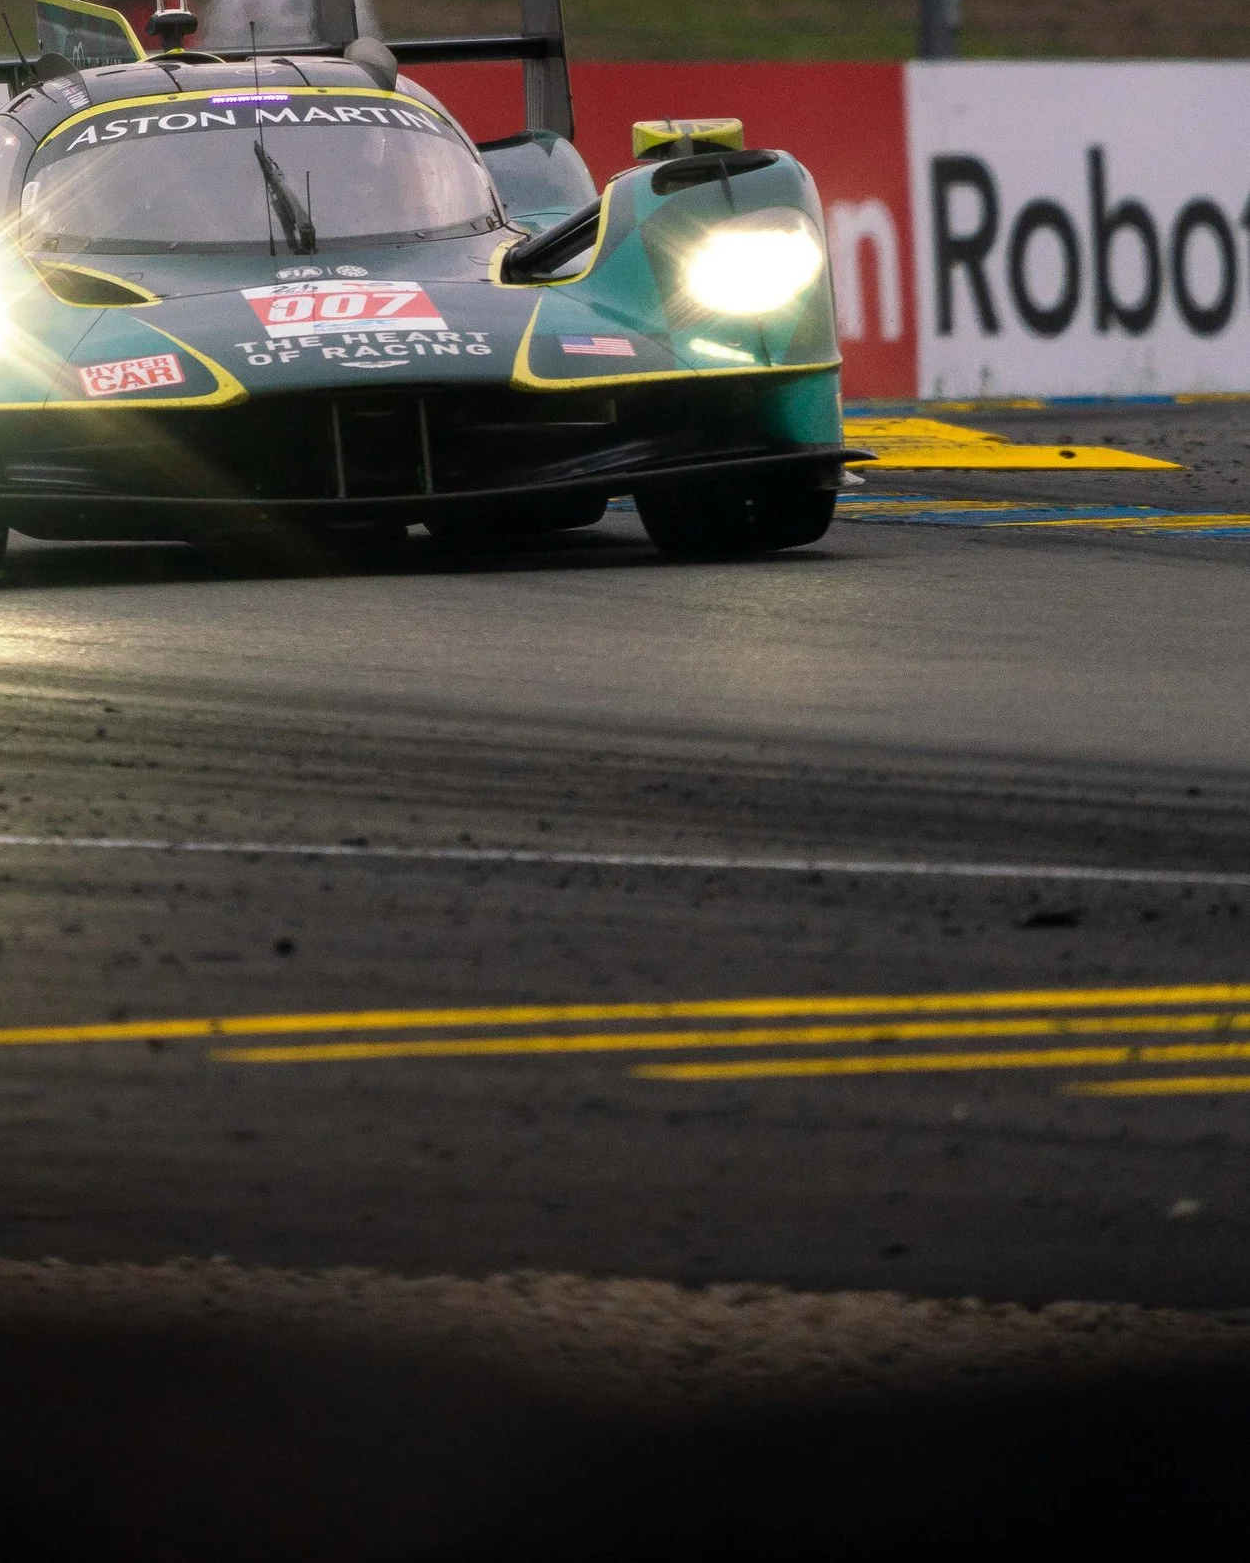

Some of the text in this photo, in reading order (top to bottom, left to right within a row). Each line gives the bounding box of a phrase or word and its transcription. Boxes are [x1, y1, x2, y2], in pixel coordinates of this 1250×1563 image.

[65, 106, 442, 152] ASTON MARTIN
[929, 142, 1250, 337] Robo
[278, 267, 321, 279] FIA
[267, 293, 418, 322] 007
[235, 331, 490, 354] THE HEART
[247, 343, 493, 366] OF RACING
[85, 358, 169, 378] HYPER
[90, 367, 175, 392] CAR
